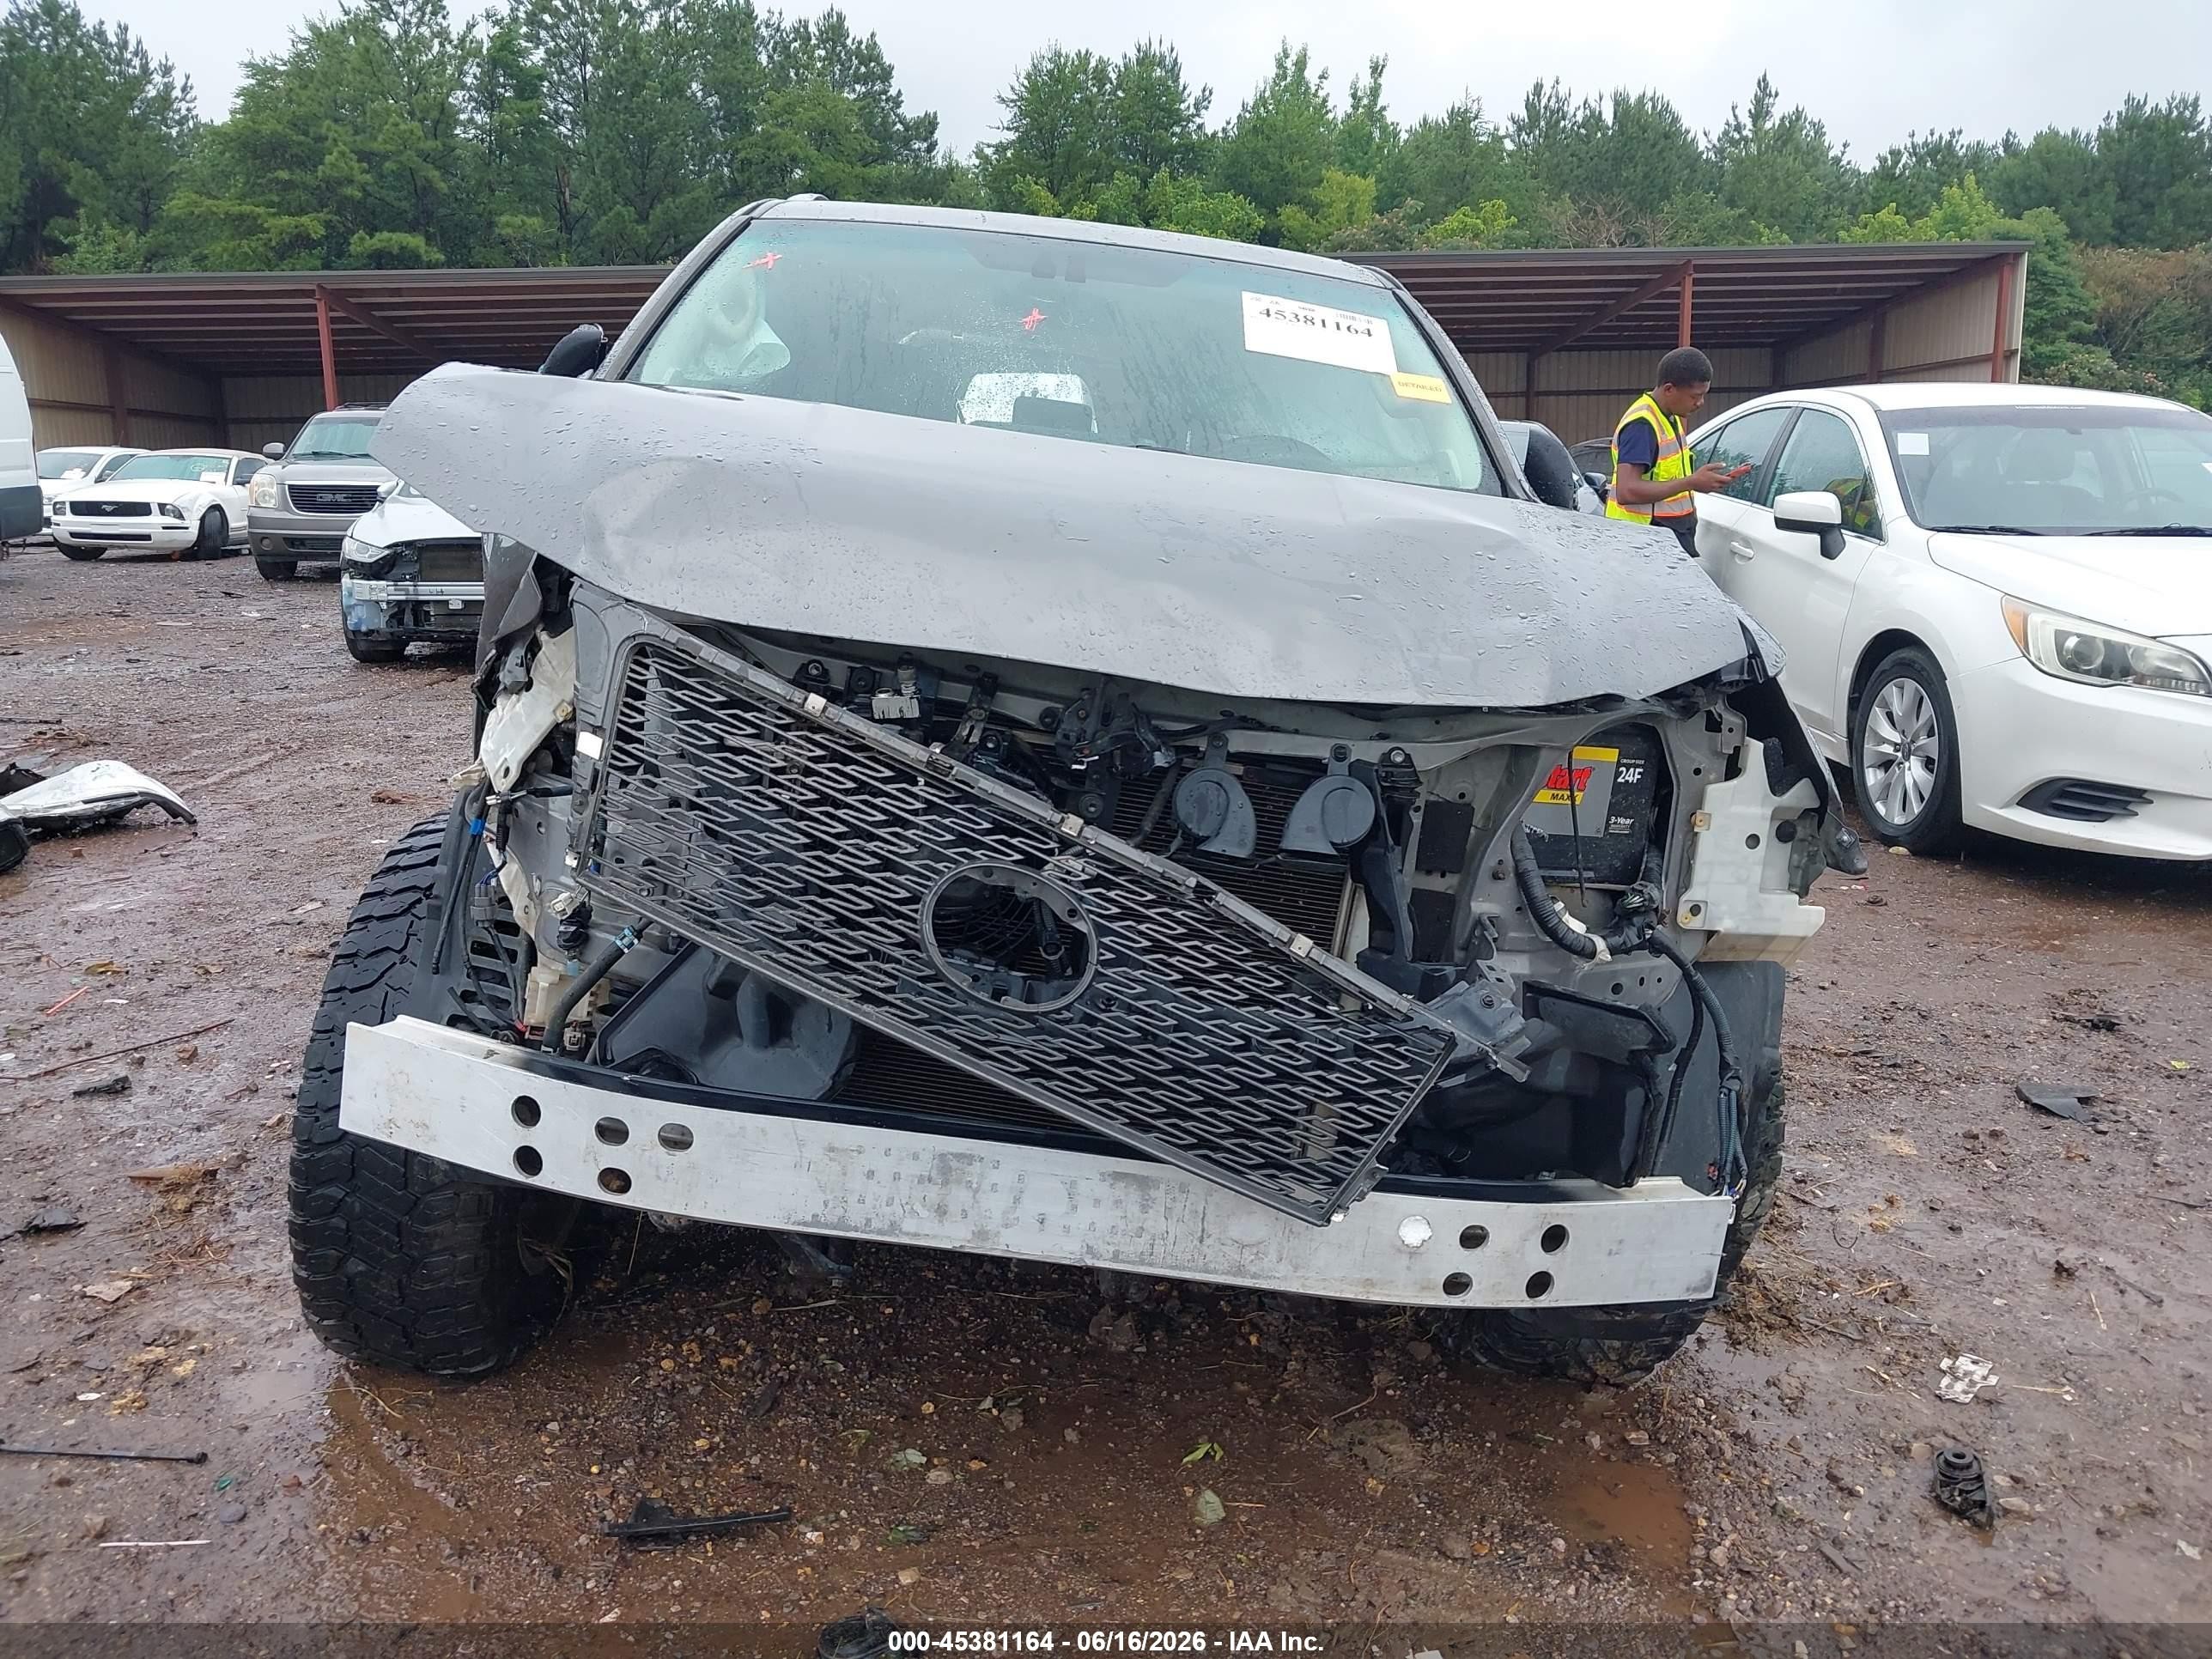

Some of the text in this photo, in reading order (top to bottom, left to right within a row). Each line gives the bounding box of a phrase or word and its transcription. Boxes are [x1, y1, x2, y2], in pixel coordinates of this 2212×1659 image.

[1259, 307, 1373, 337] 45381164
[316, 493, 352, 502] GMC
[1547, 764, 1592, 791] tart
[1617, 766, 1644, 784] 24F
[1551, 793, 1578, 802] MAXX
